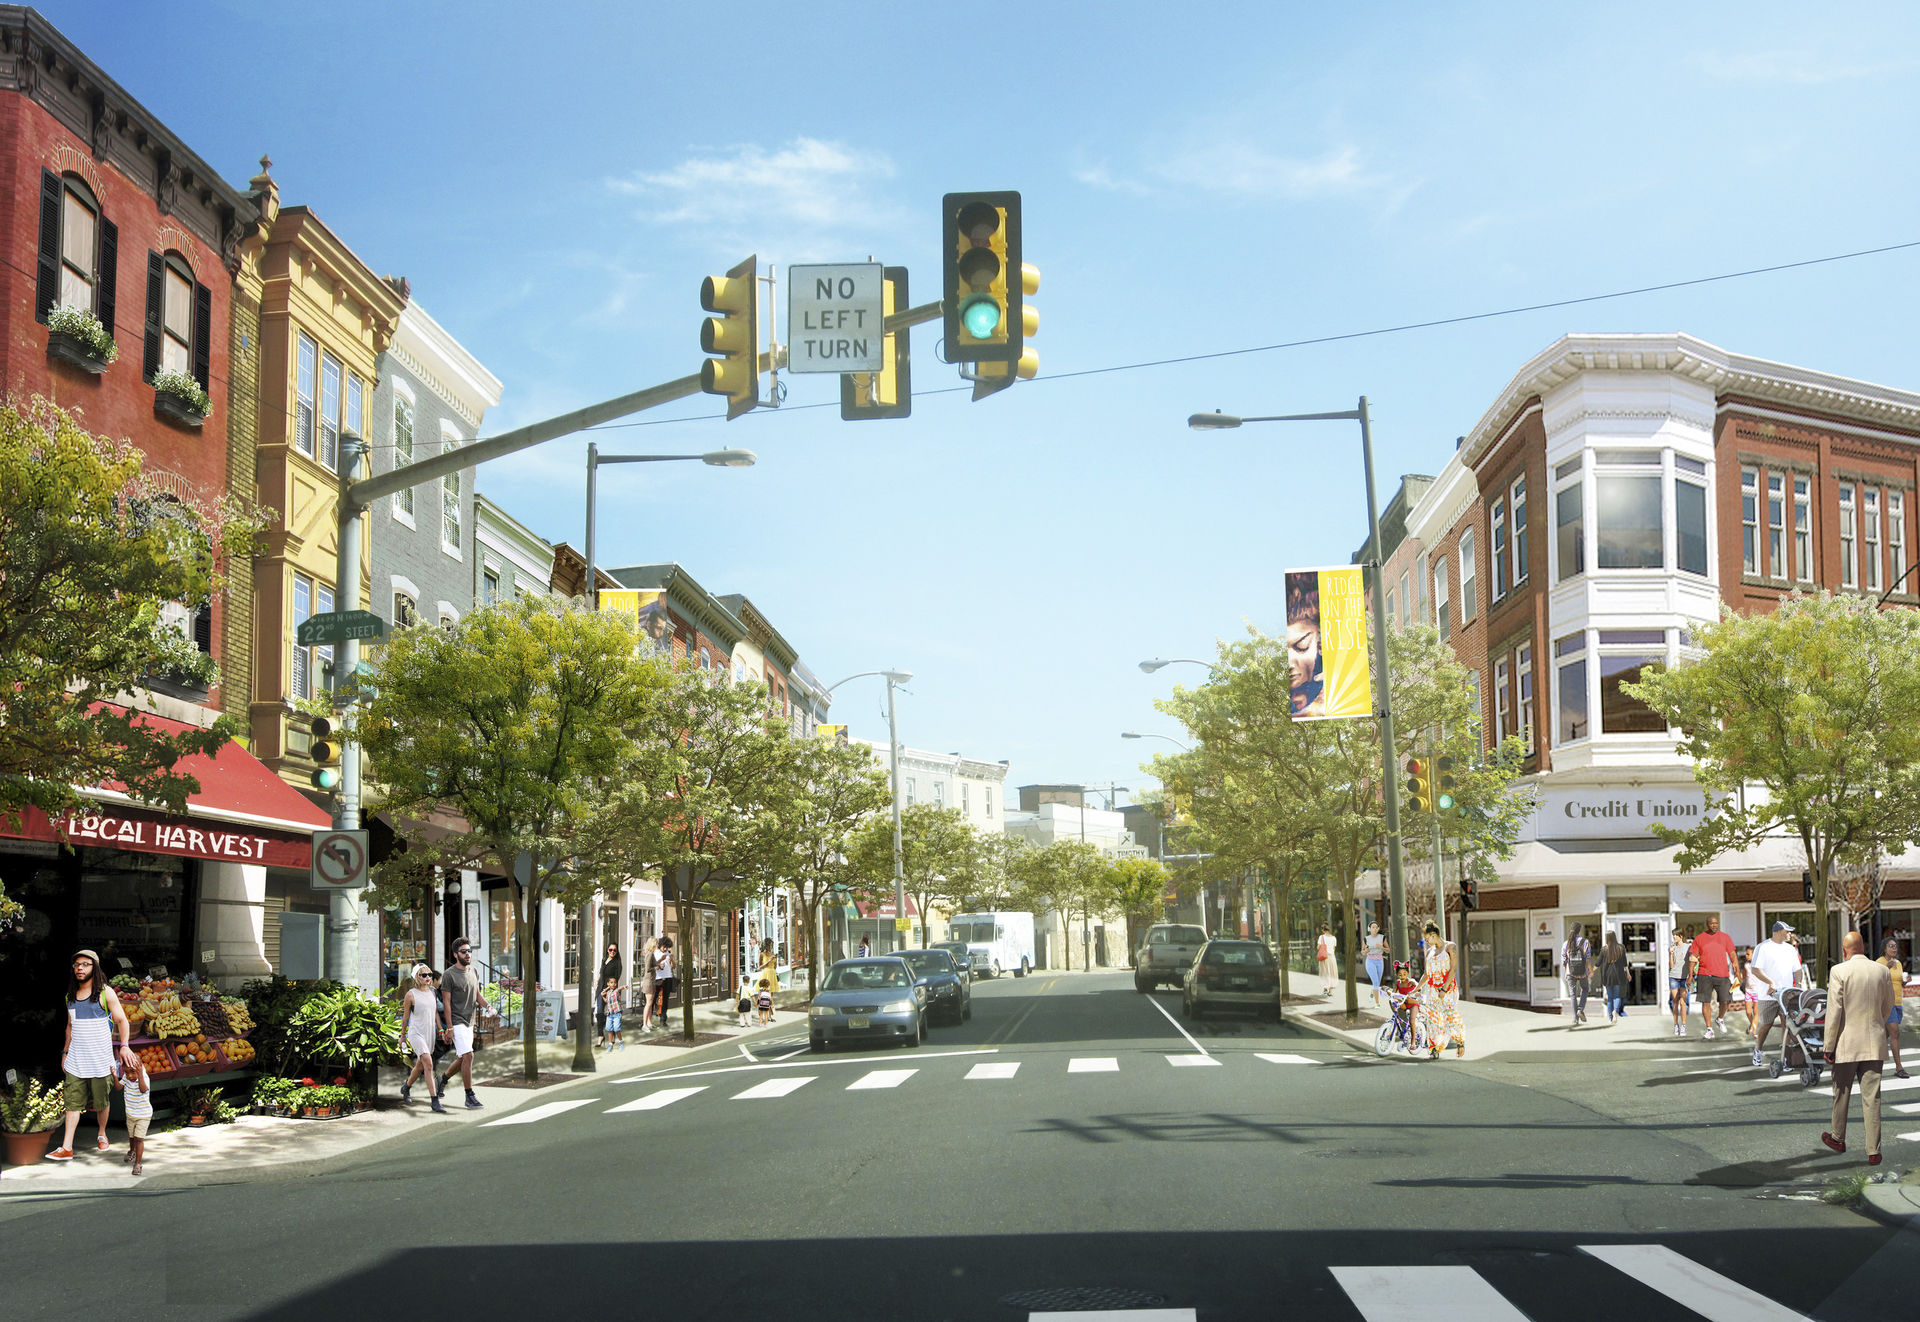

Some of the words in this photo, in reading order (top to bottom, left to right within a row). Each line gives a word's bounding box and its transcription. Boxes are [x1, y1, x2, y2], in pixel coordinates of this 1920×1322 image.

[816, 277, 855, 300] NO
[804, 309, 867, 330] LEFT
[804, 338, 867, 359] TURN
[1327, 576, 1361, 596] RIDGE
[337, 613, 344, 622] N
[1322, 599, 1340, 618] ON
[1344, 597, 1362, 617] THE
[345, 625, 375, 639] STEET
[1324, 618, 1365, 651] RISE
[1564, 800, 1630, 818] Credit
[1636, 799, 1698, 817] Union
[68, 815, 146, 844] LOCAL
[155, 824, 270, 859] HARVEST
